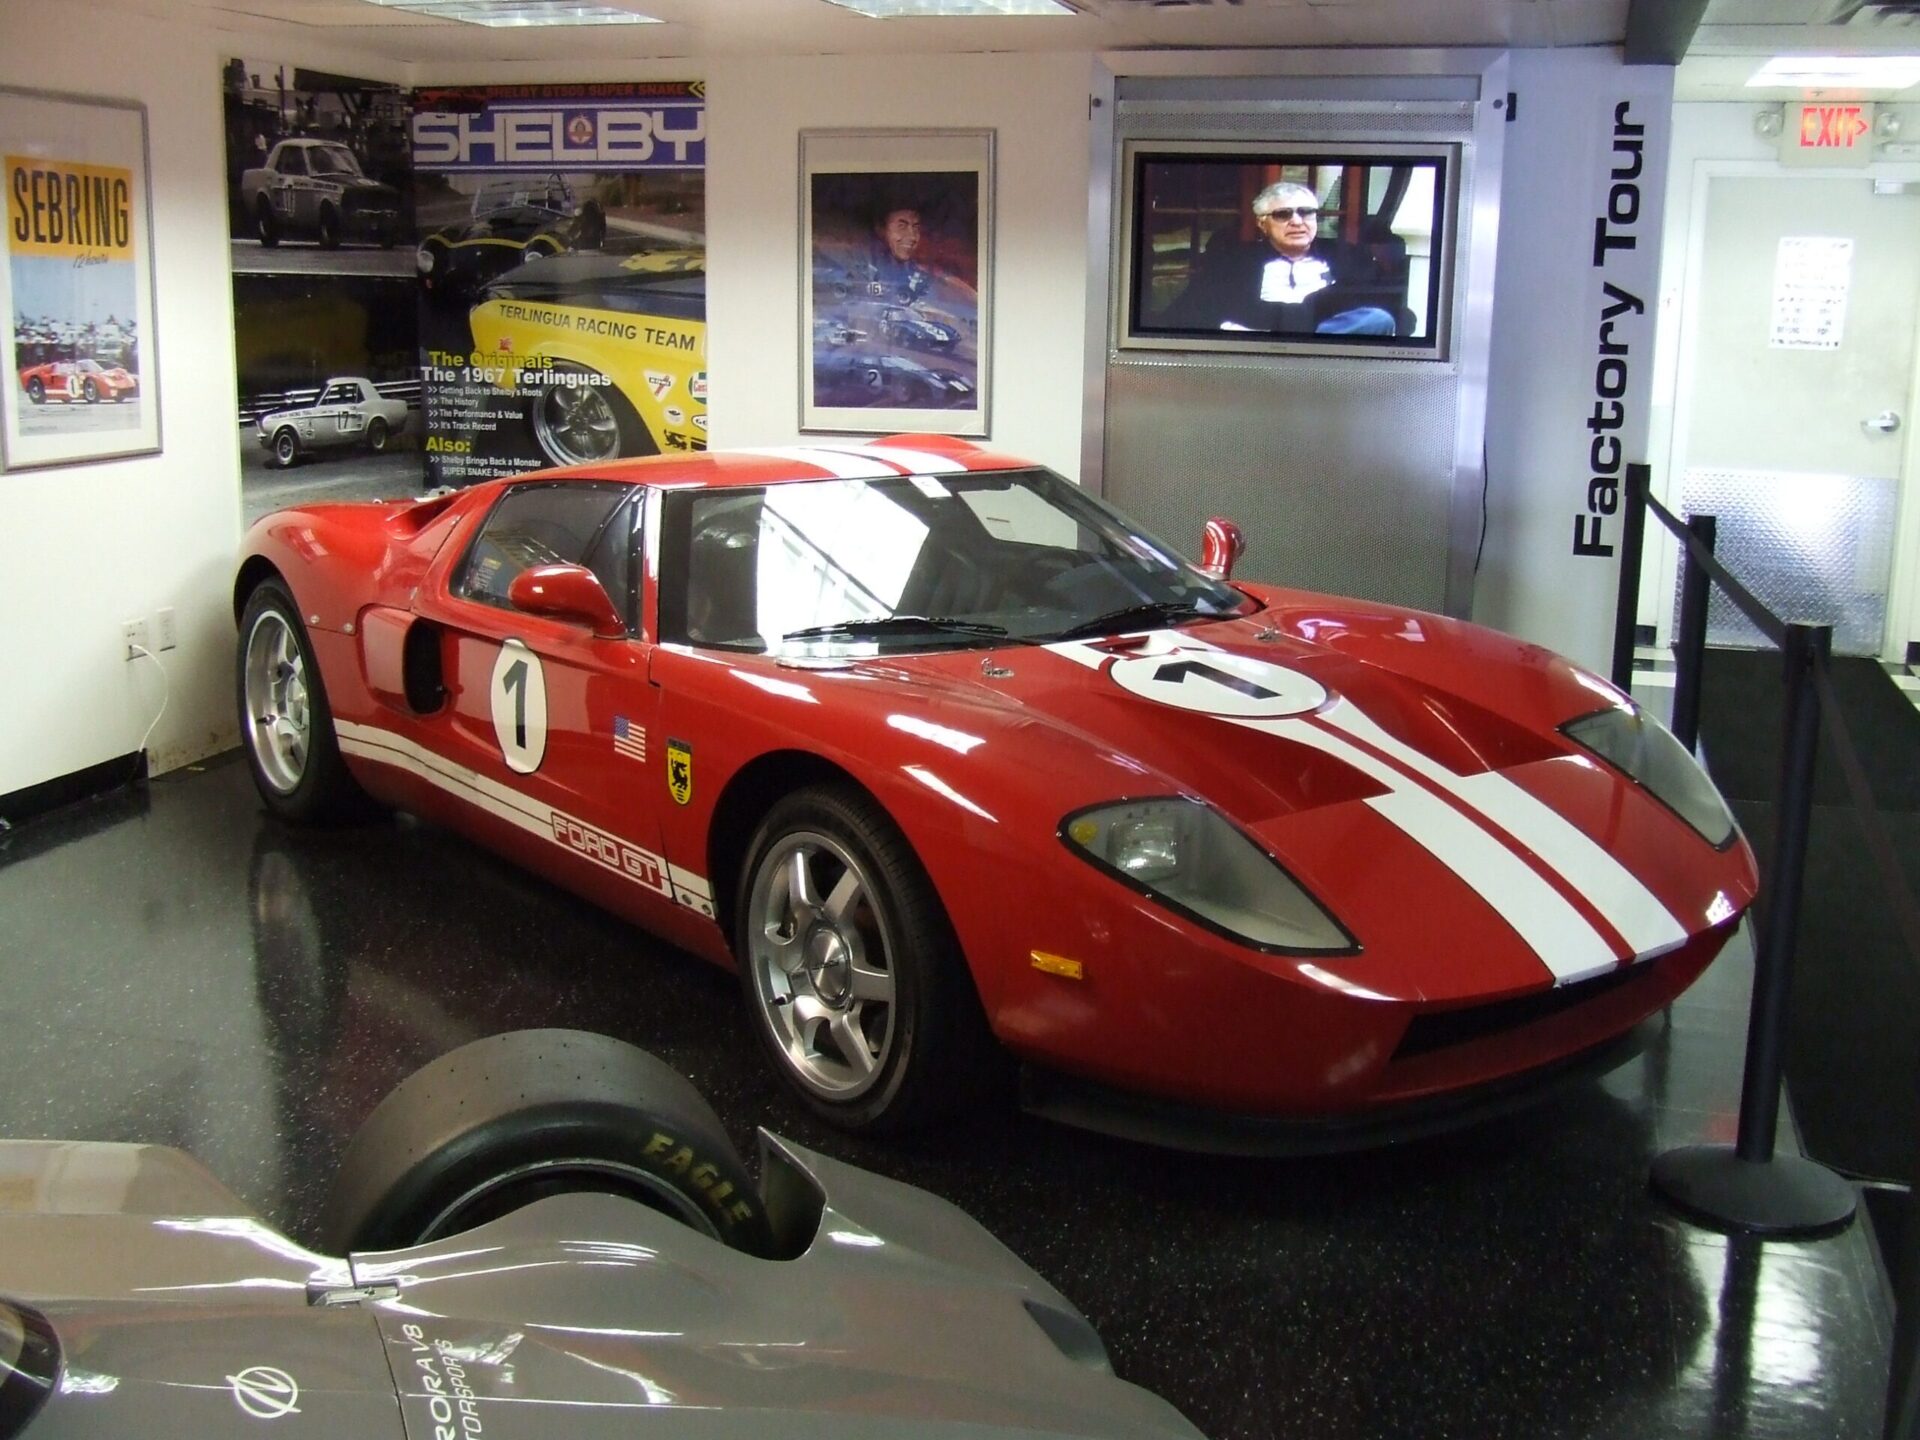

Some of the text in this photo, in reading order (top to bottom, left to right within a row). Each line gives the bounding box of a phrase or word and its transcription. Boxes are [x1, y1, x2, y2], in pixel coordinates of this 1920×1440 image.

[589, 84, 634, 96] SUPER
[638, 82, 685, 95] SNAKE
[413, 111, 706, 162] SHELBY
[1800, 107, 1861, 148] EXIT
[13, 166, 129, 248] SEBRING
[499, 304, 696, 351] TERLINGUA RACING TEAM
[1572, 101, 1645, 558] Factory Tour
[428, 351, 553, 369] The Originals
[420, 366, 612, 389] The 1967 Terlinguas
[439, 386, 543, 398] Getting Back to Shelby's Roots
[440, 398, 479, 408] The History
[440, 409, 523, 420] The Performance & Value
[452, 422, 471, 431] Track
[472, 422, 497, 431] Record
[425, 437, 471, 453] Also:
[441, 456, 464, 466] Shelby
[465, 456, 488, 466] Brings
[489, 457, 507, 466] Back
[513, 458, 542, 467] Monster
[441, 467, 465, 476] SUPER
[467, 467, 492, 476] SNAKE
[493, 468, 514, 477] Sneak
[1152, 660, 1283, 700] 1
[503, 659, 528, 750] 1
[553, 813, 658, 883] FORD GT
[643, 1132, 753, 1224] EAGLE
[402, 1323, 429, 1352] V8
